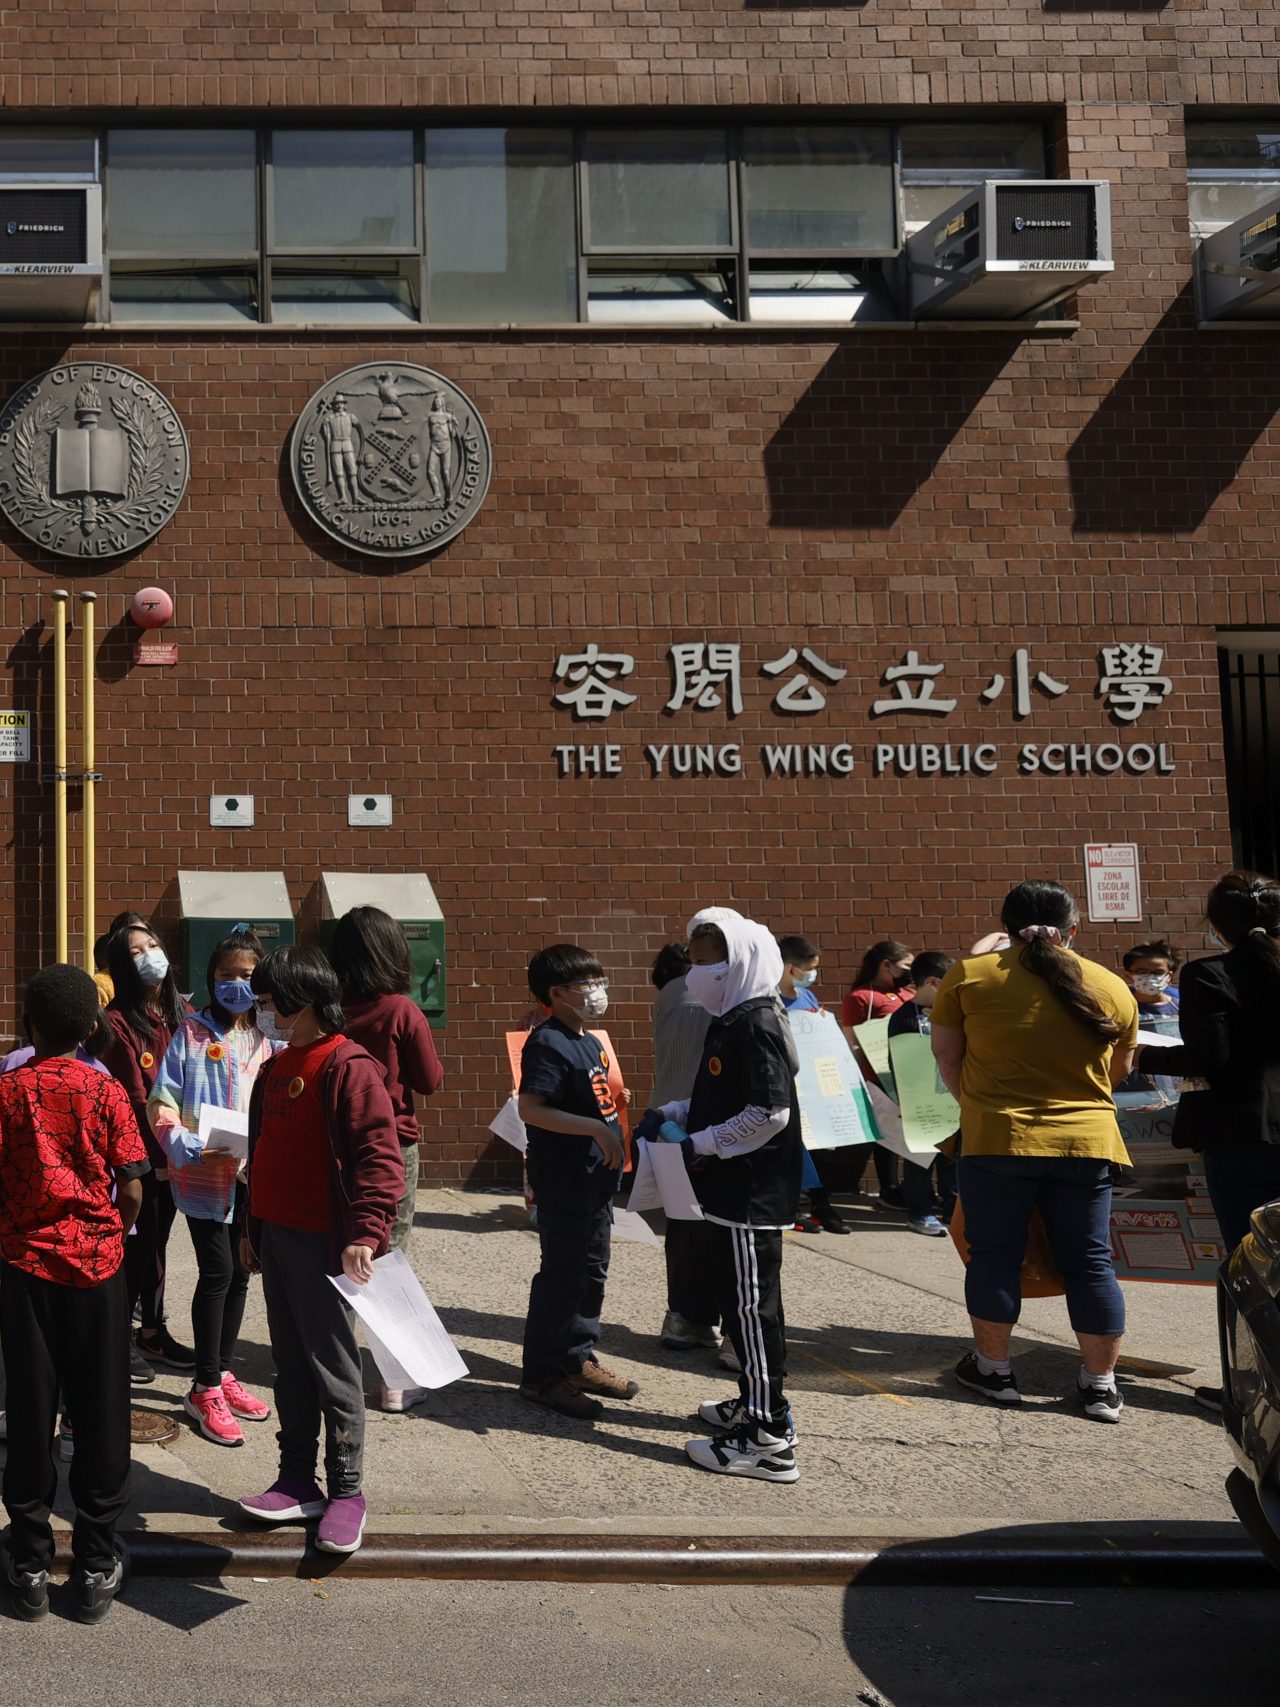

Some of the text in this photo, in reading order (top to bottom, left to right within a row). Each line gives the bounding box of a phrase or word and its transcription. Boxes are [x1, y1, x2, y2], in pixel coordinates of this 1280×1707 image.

[19, 224, 64, 232] FRIEDRICH
[14, 265, 74, 273] KLEARVIEW
[1028, 260, 1089, 270] KLEARVIEW
[52, 368, 79, 385] OF
[92, 366, 184, 448] EDUCATION
[38, 529, 66, 549] OF
[80, 533, 128, 555] NEW
[136, 483, 180, 537] YORK
[372, 512, 412, 527] 1664
[557, 744, 1175, 773] THE YUNG WING PUBLIC SCHOOL
[1089, 849, 1102, 863] NO
[1103, 872, 1122, 880] ZONA
[1097, 882, 1130, 890] ESCOLAR
[1098, 892, 1130, 900] LIBRE DE
[1105, 903, 1125, 911] ASMA
